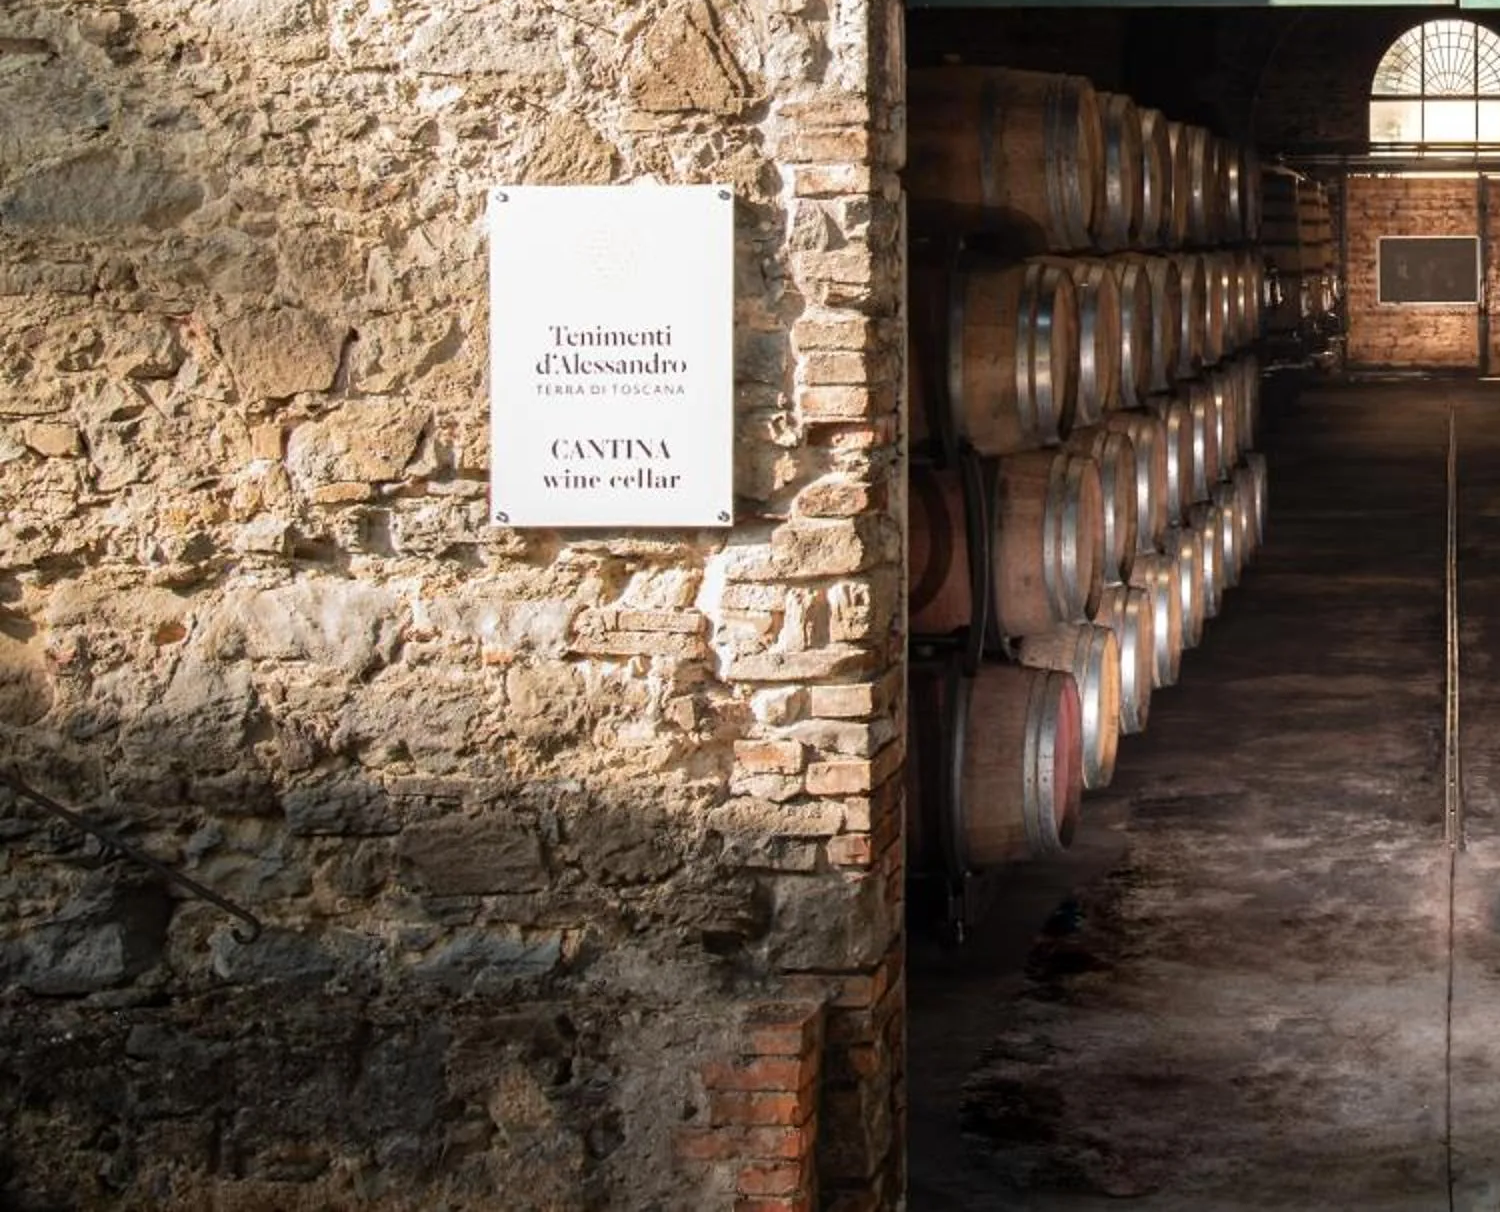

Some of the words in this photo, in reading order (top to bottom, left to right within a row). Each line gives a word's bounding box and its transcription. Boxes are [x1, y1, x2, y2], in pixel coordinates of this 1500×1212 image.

[548, 324, 672, 348] Tenimenti
[536, 383, 585, 397] TERRA
[590, 383, 607, 397] DI
[612, 383, 686, 397] TOSCANA
[550, 438, 672, 461] CANTINA
[543, 466, 602, 490] wine
[609, 466, 682, 490] cellar
